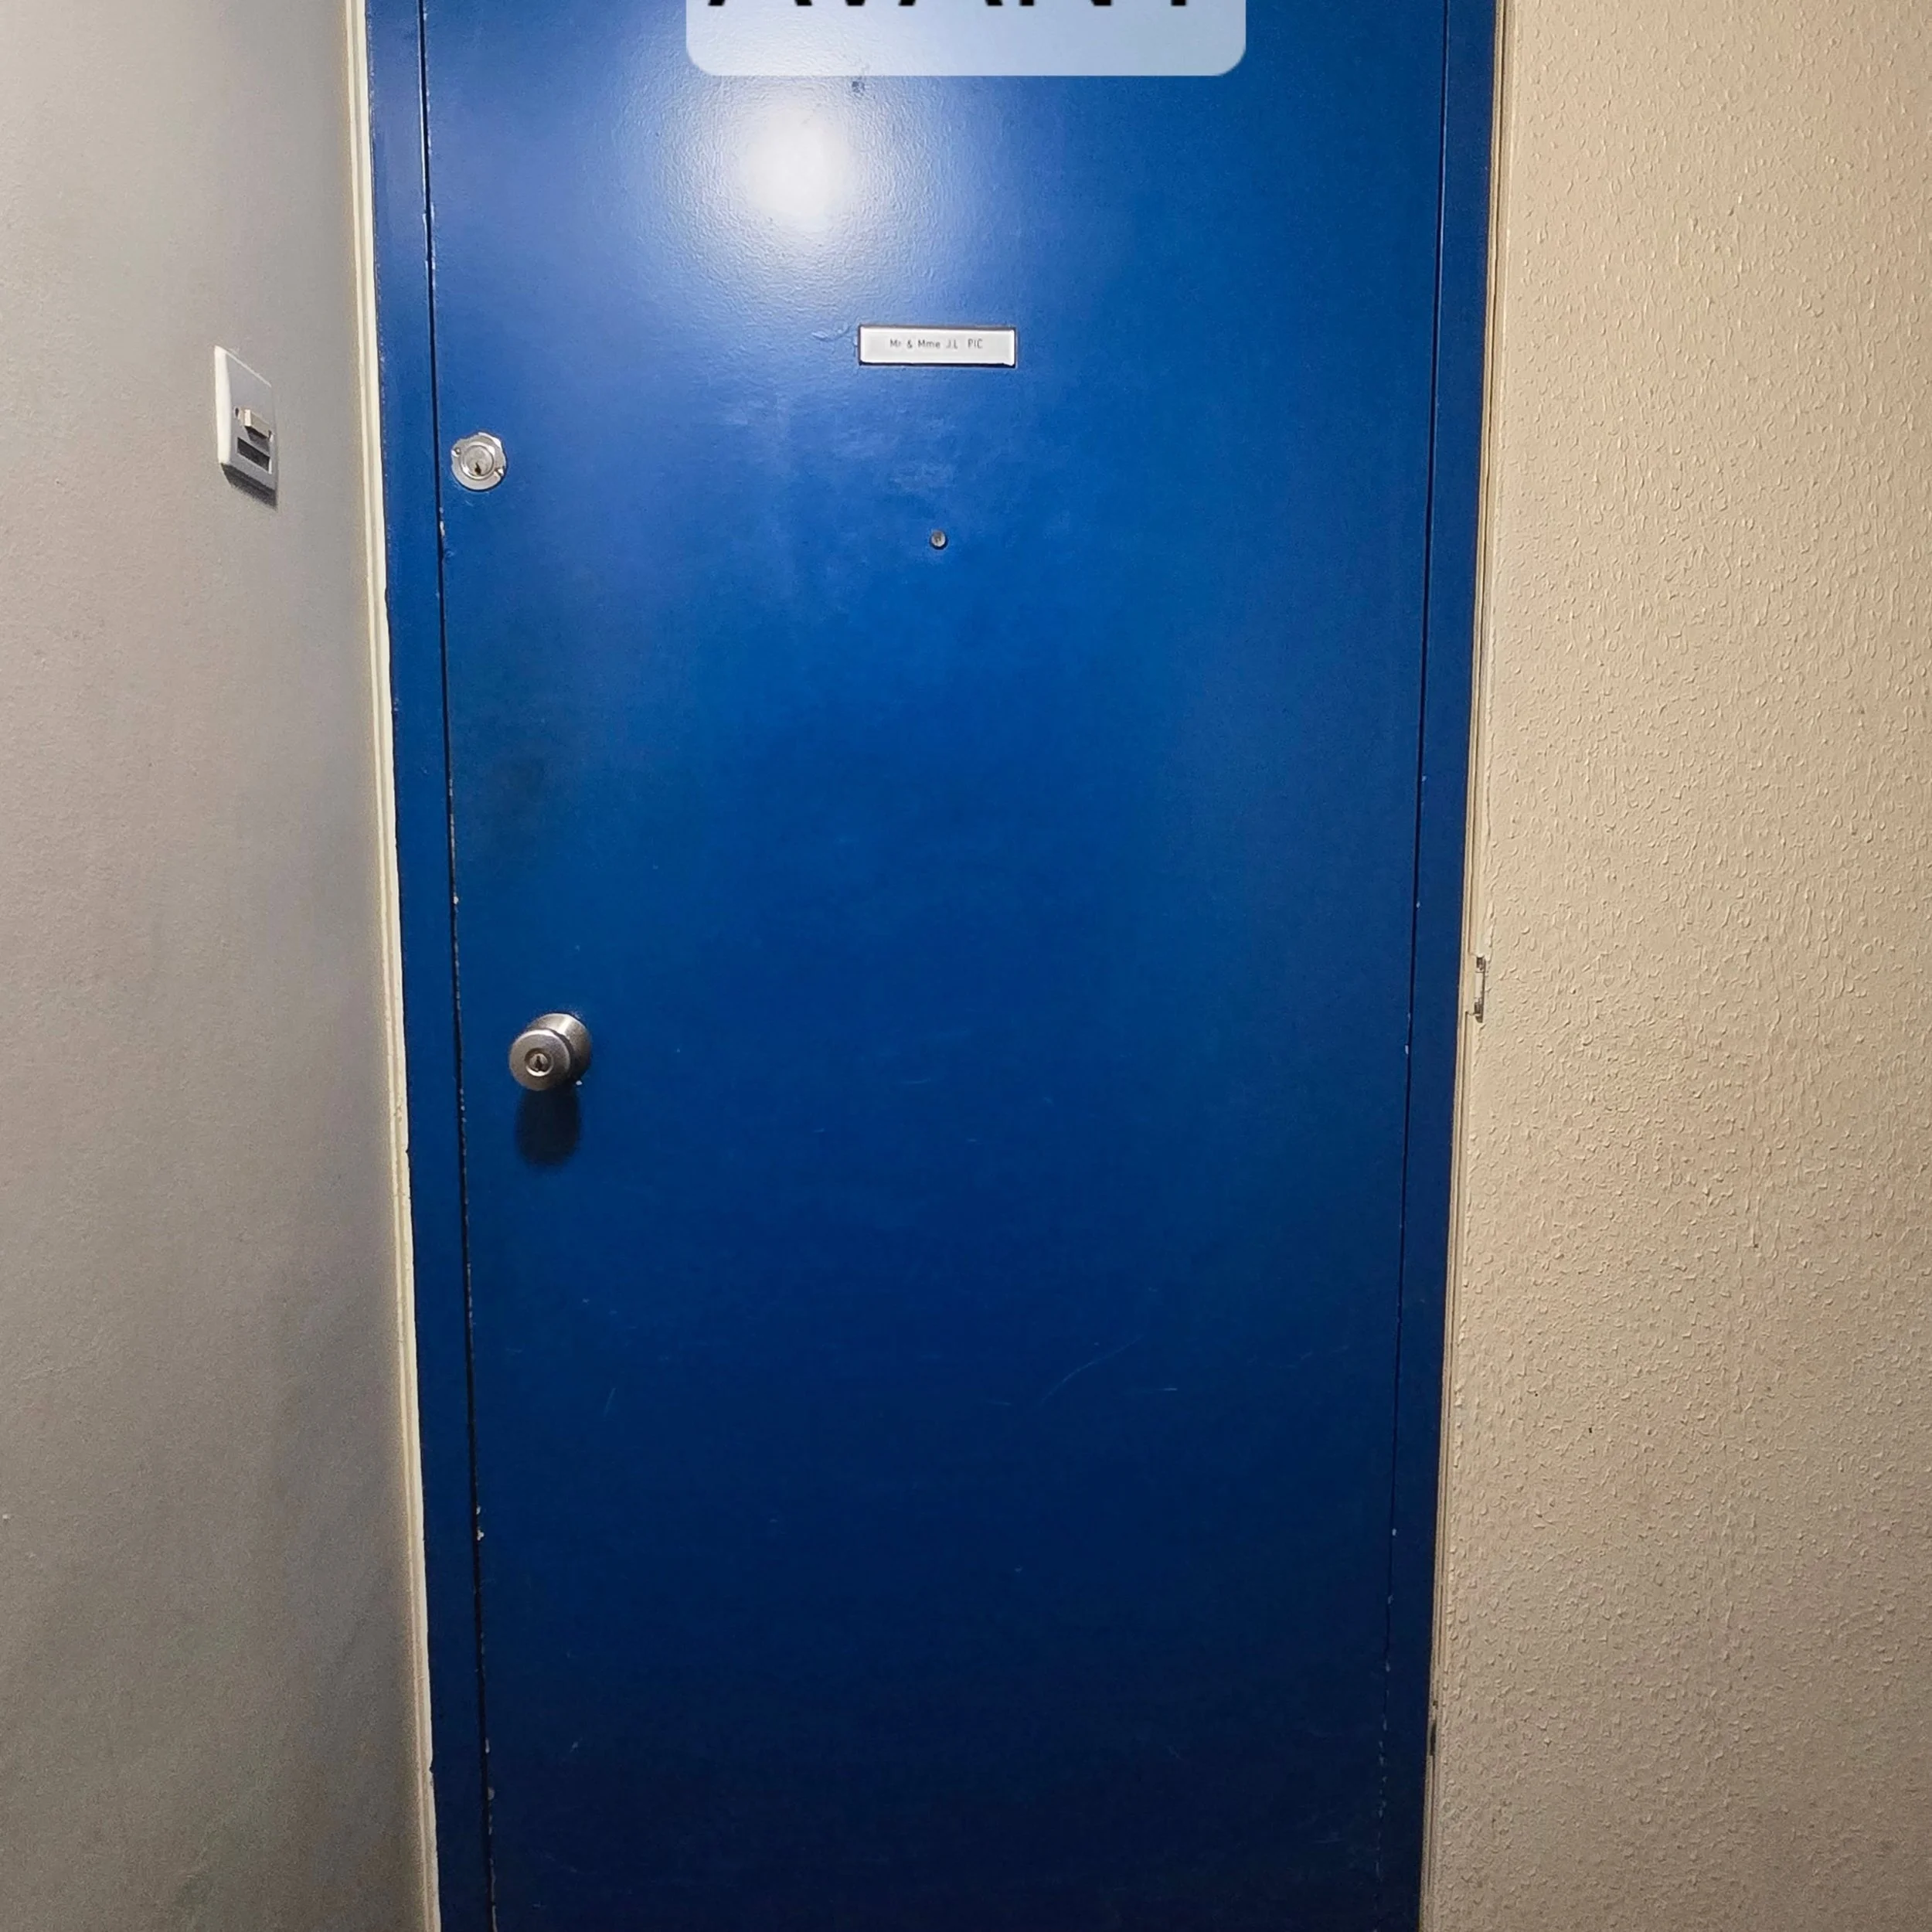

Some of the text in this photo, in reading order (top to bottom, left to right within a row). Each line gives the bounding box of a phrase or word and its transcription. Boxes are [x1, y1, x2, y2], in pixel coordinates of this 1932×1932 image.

[889, 338, 902, 348] Mr
[906, 339, 913, 349] &
[917, 338, 940, 349] Mme
[967, 338, 983, 349] PIC
